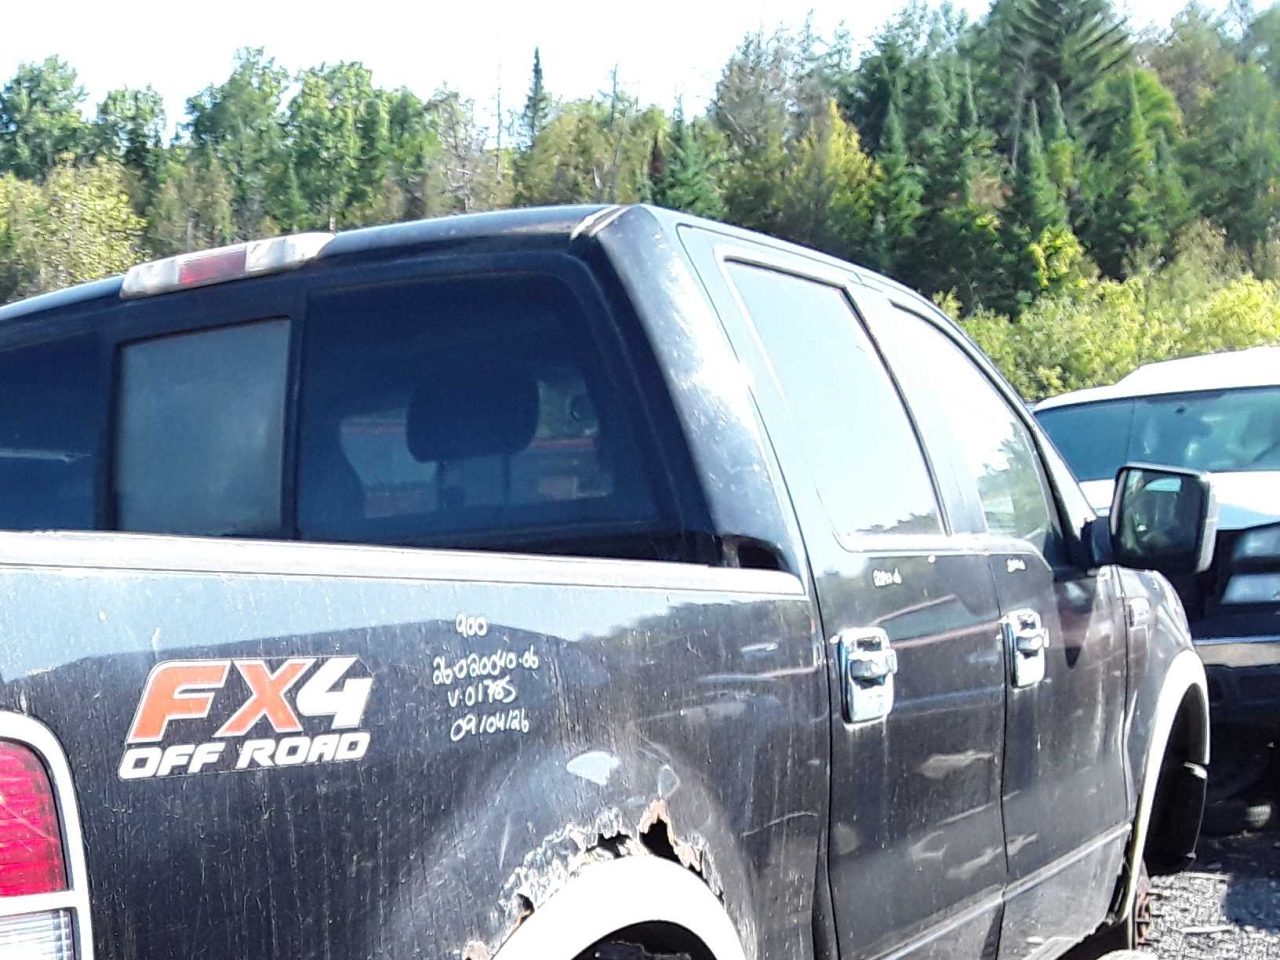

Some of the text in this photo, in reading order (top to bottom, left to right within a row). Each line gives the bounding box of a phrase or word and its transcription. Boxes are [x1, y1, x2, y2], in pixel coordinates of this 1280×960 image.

[125, 657, 373, 743] FX4
[119, 732, 370, 779] OFF ROAD
